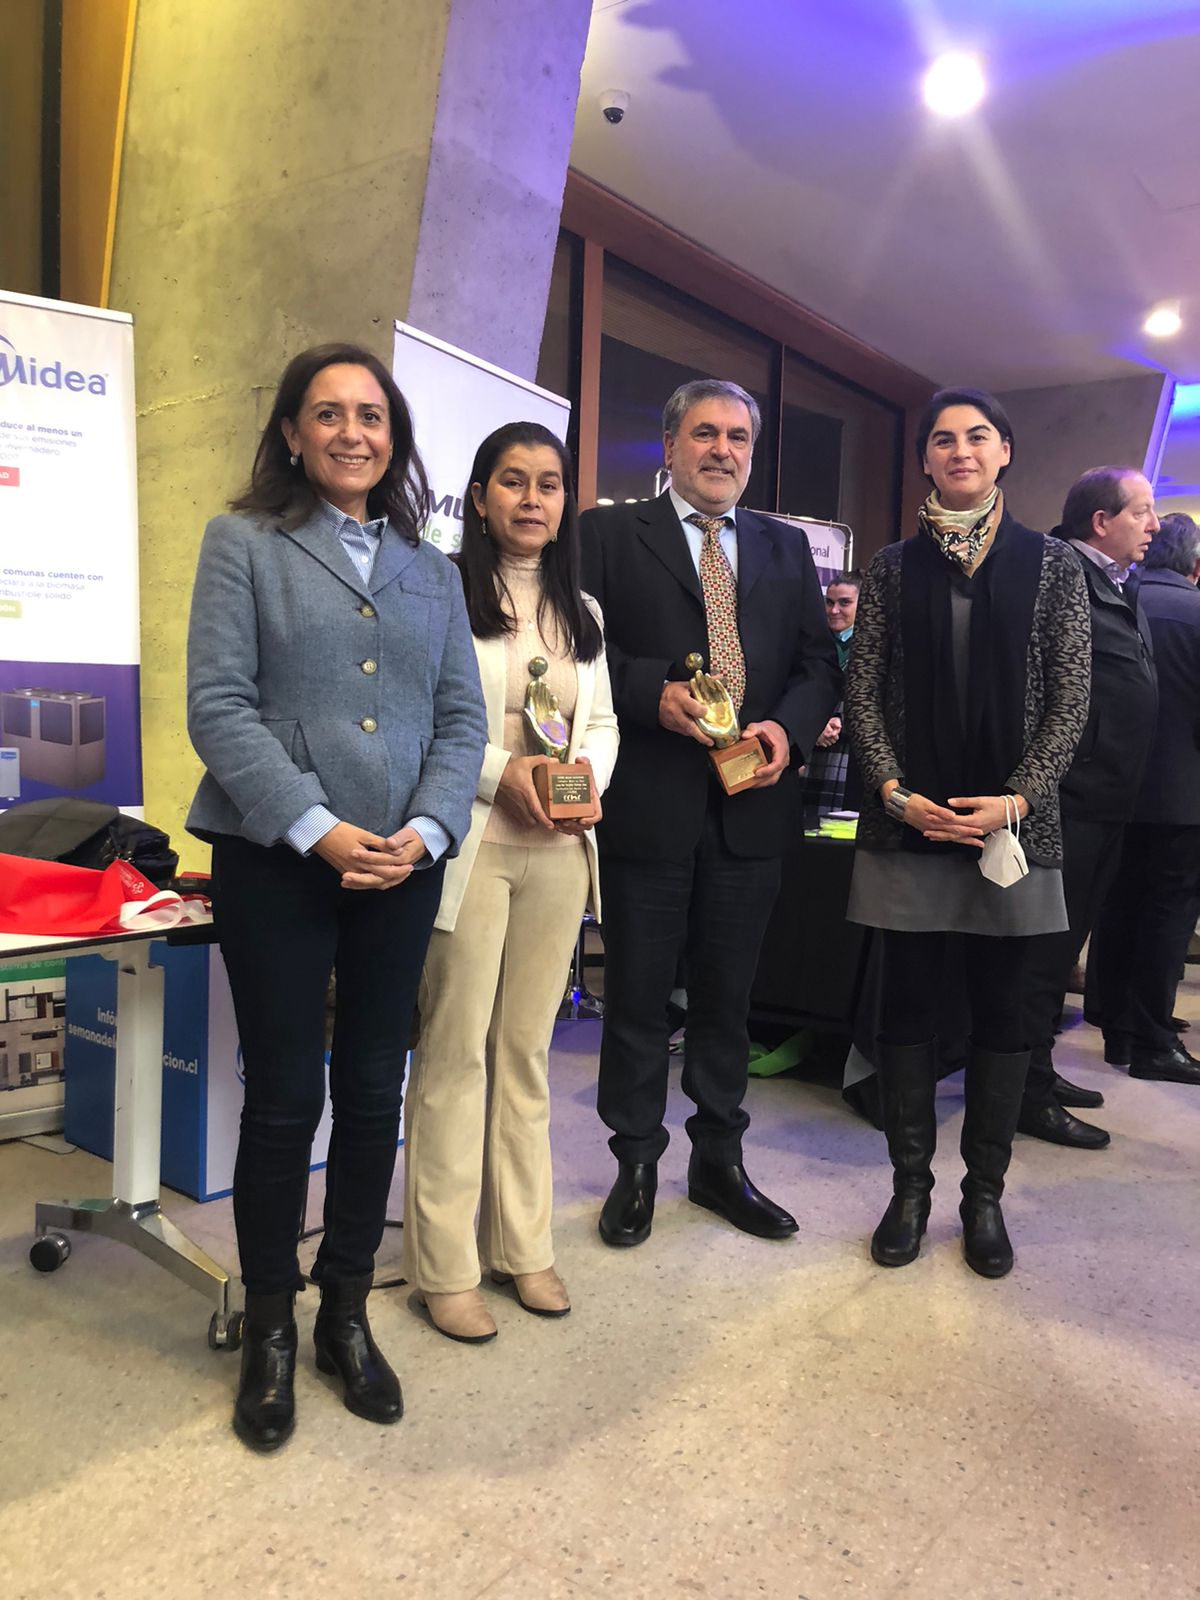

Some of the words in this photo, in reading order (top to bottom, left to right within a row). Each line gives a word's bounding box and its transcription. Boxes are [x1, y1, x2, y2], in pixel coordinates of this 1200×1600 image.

[0, 351, 106, 396] Midea
[38, 425, 69, 436] menos
[71, 430, 83, 438] un
[3, 568, 45, 577] comunas
[48, 571, 85, 580] cuenten
[87, 574, 104, 582] con
